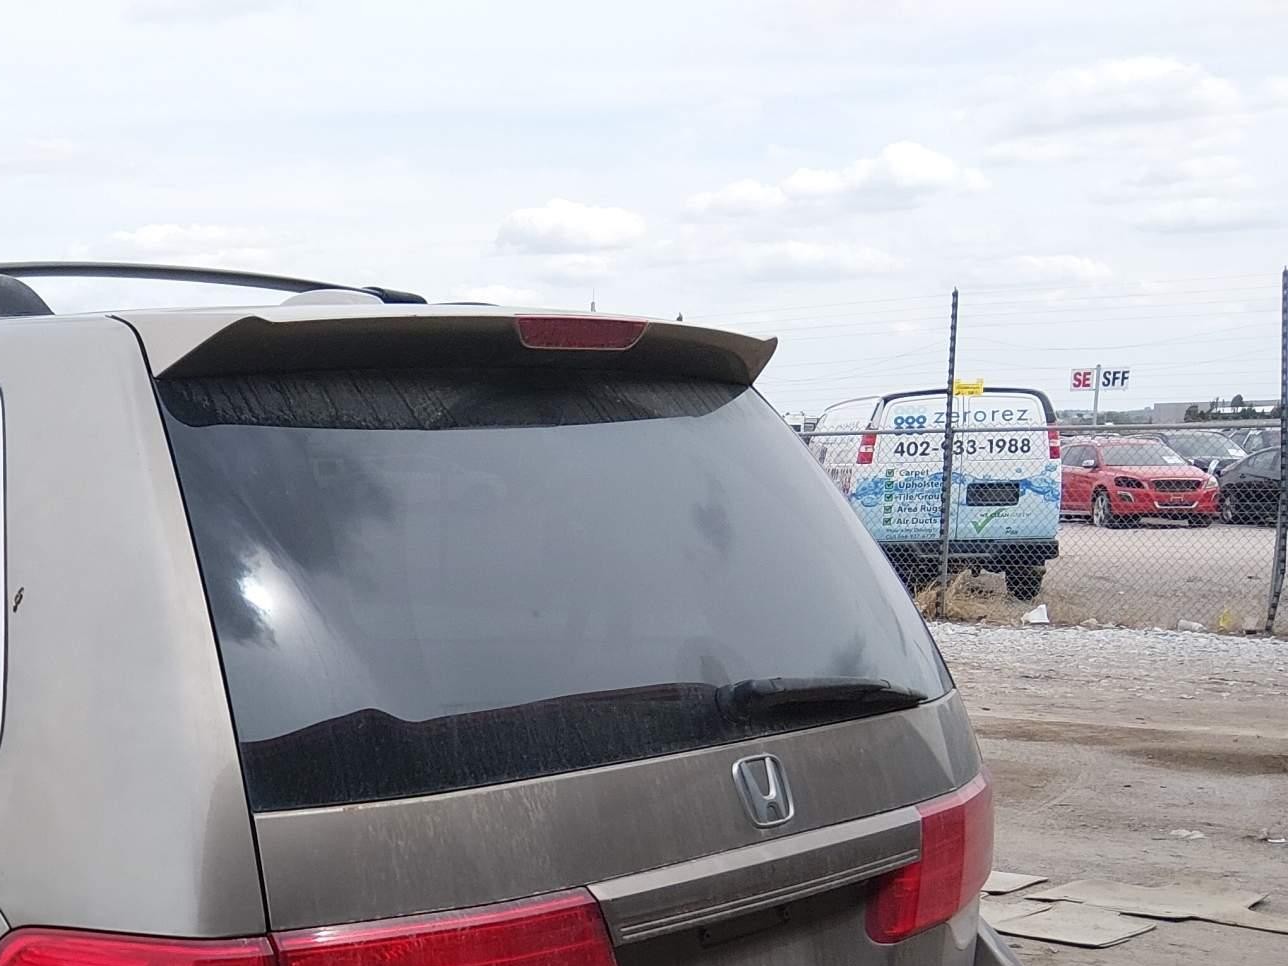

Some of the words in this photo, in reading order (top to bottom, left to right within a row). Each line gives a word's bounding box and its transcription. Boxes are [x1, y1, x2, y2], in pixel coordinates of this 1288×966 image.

[1072, 371, 1092, 388] SE
[1102, 370, 1130, 387] SFF
[933, 409, 1029, 424] zerorez
[899, 469, 929, 478] Carpet
[898, 480, 944, 489] Upholster
[898, 492, 943, 500] Tile/Grou
[897, 505, 918, 513] Area
[912, 517, 938, 525] Ducts
